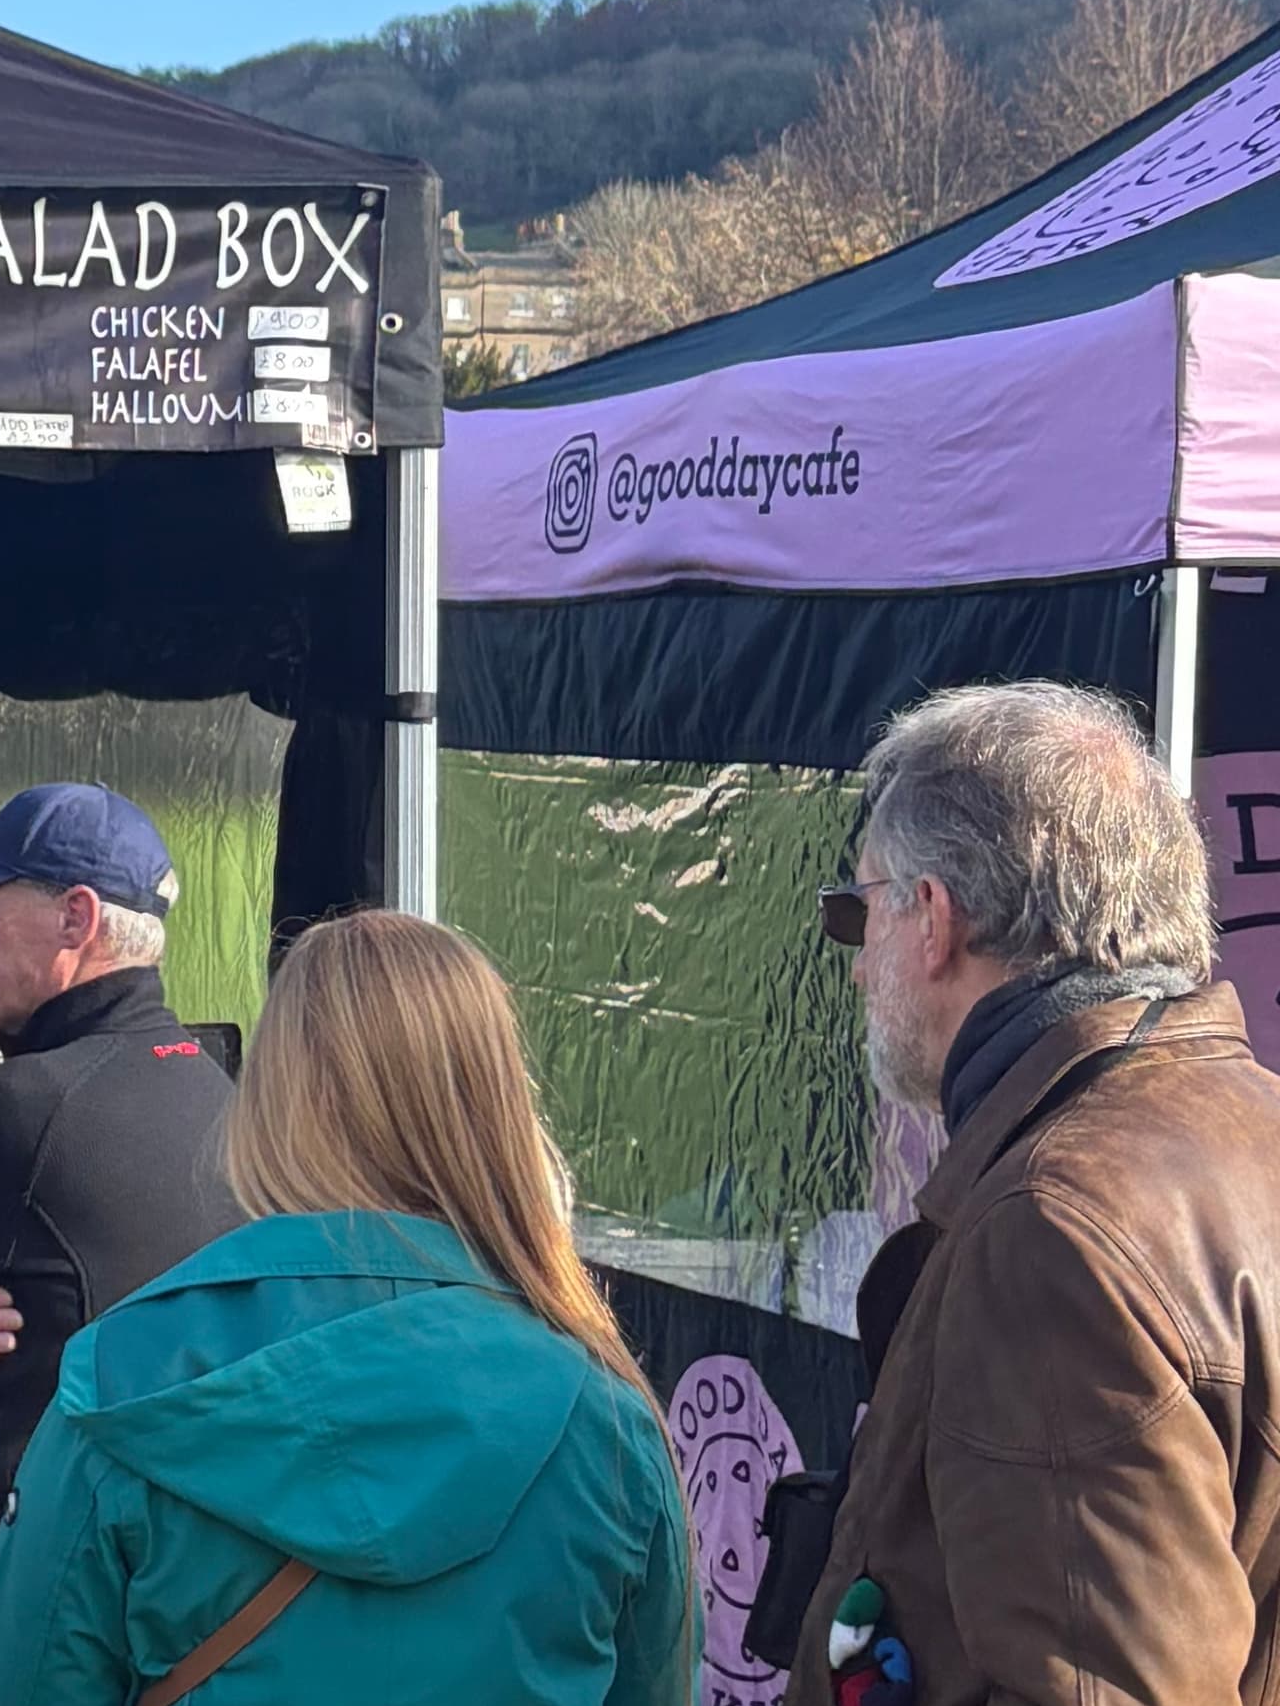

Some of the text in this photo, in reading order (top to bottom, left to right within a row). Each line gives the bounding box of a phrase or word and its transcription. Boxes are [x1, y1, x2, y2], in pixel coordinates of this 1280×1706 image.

[215, 200, 370, 294] BOX
[91, 304, 225, 342] CHICKEN
[91, 347, 208, 384] FALAFEL
[91, 391, 252, 425] HALLOUMI
[607, 425, 861, 523] @gooddaycafe
